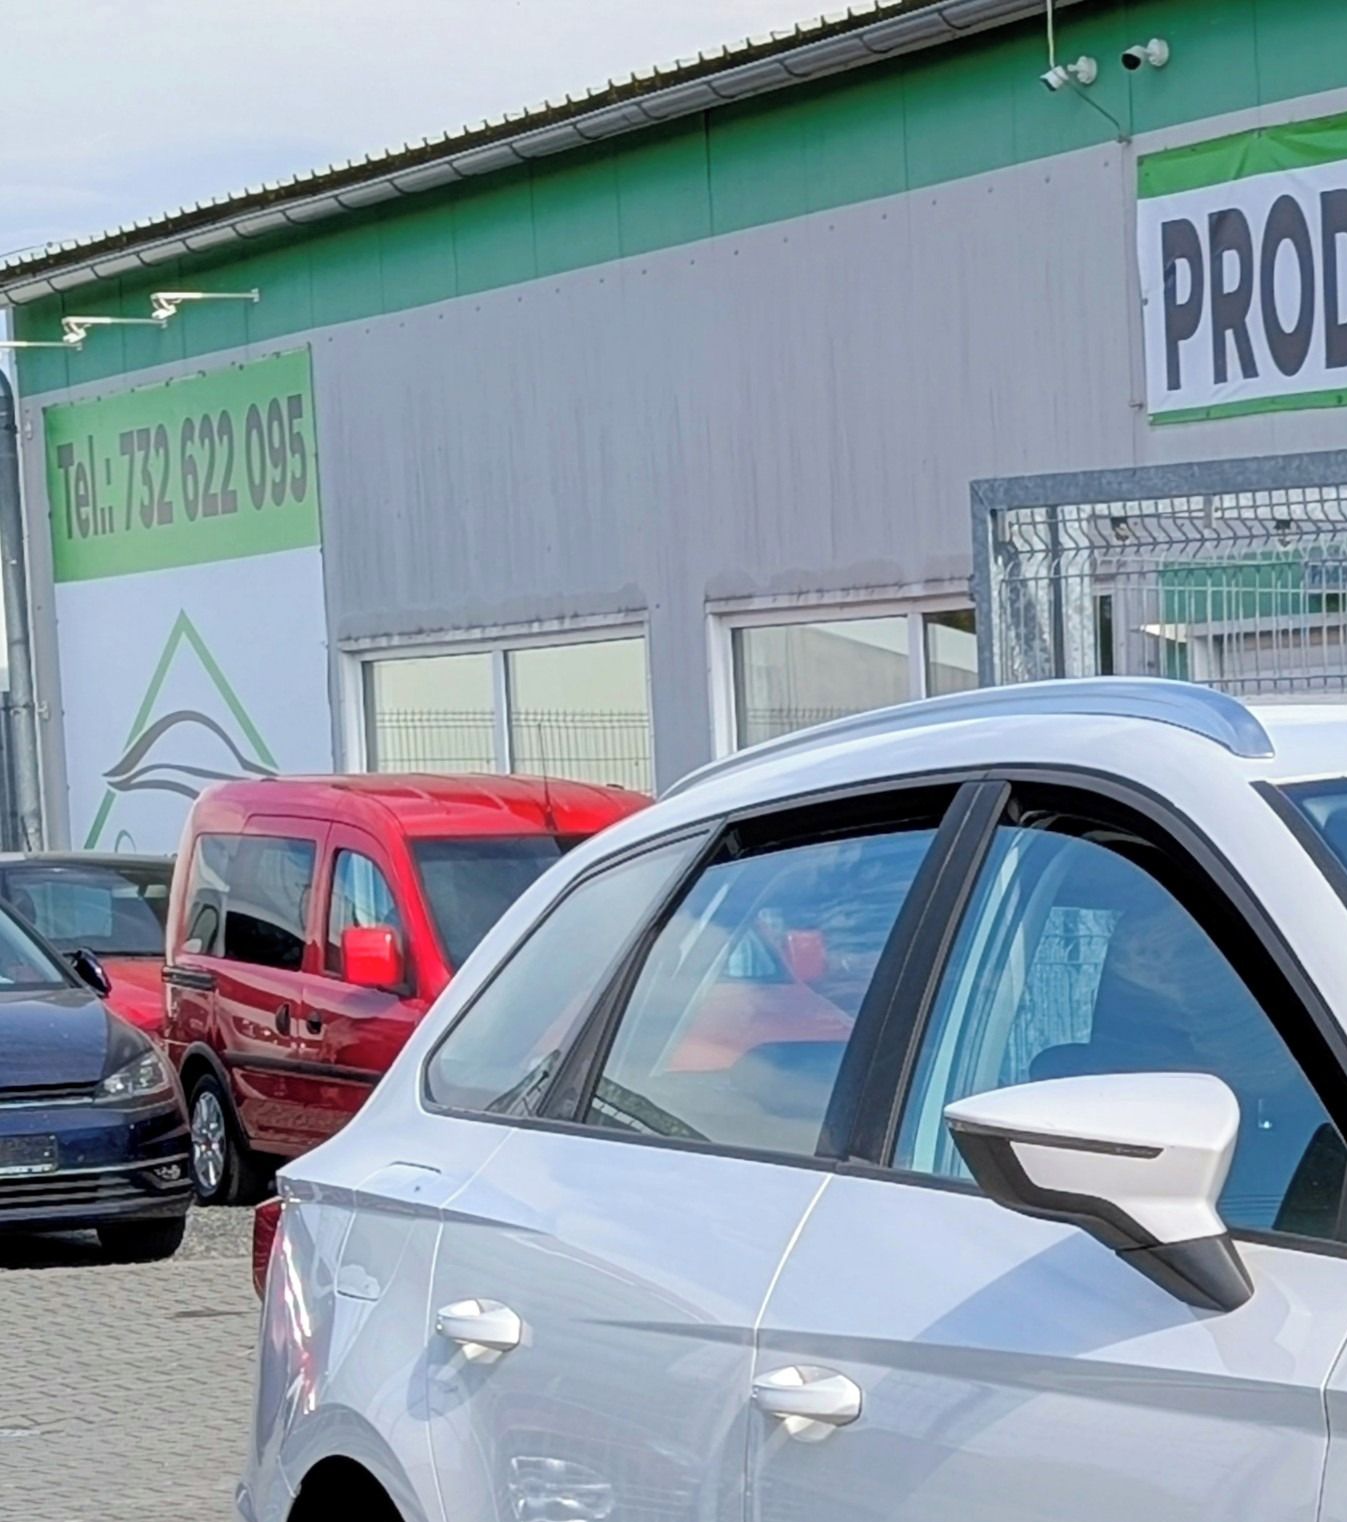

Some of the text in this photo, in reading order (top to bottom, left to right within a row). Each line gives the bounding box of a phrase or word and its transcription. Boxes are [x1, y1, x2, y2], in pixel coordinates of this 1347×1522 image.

[119, 423, 174, 531] 732
[180, 409, 238, 522] 622
[245, 393, 307, 511] 095
